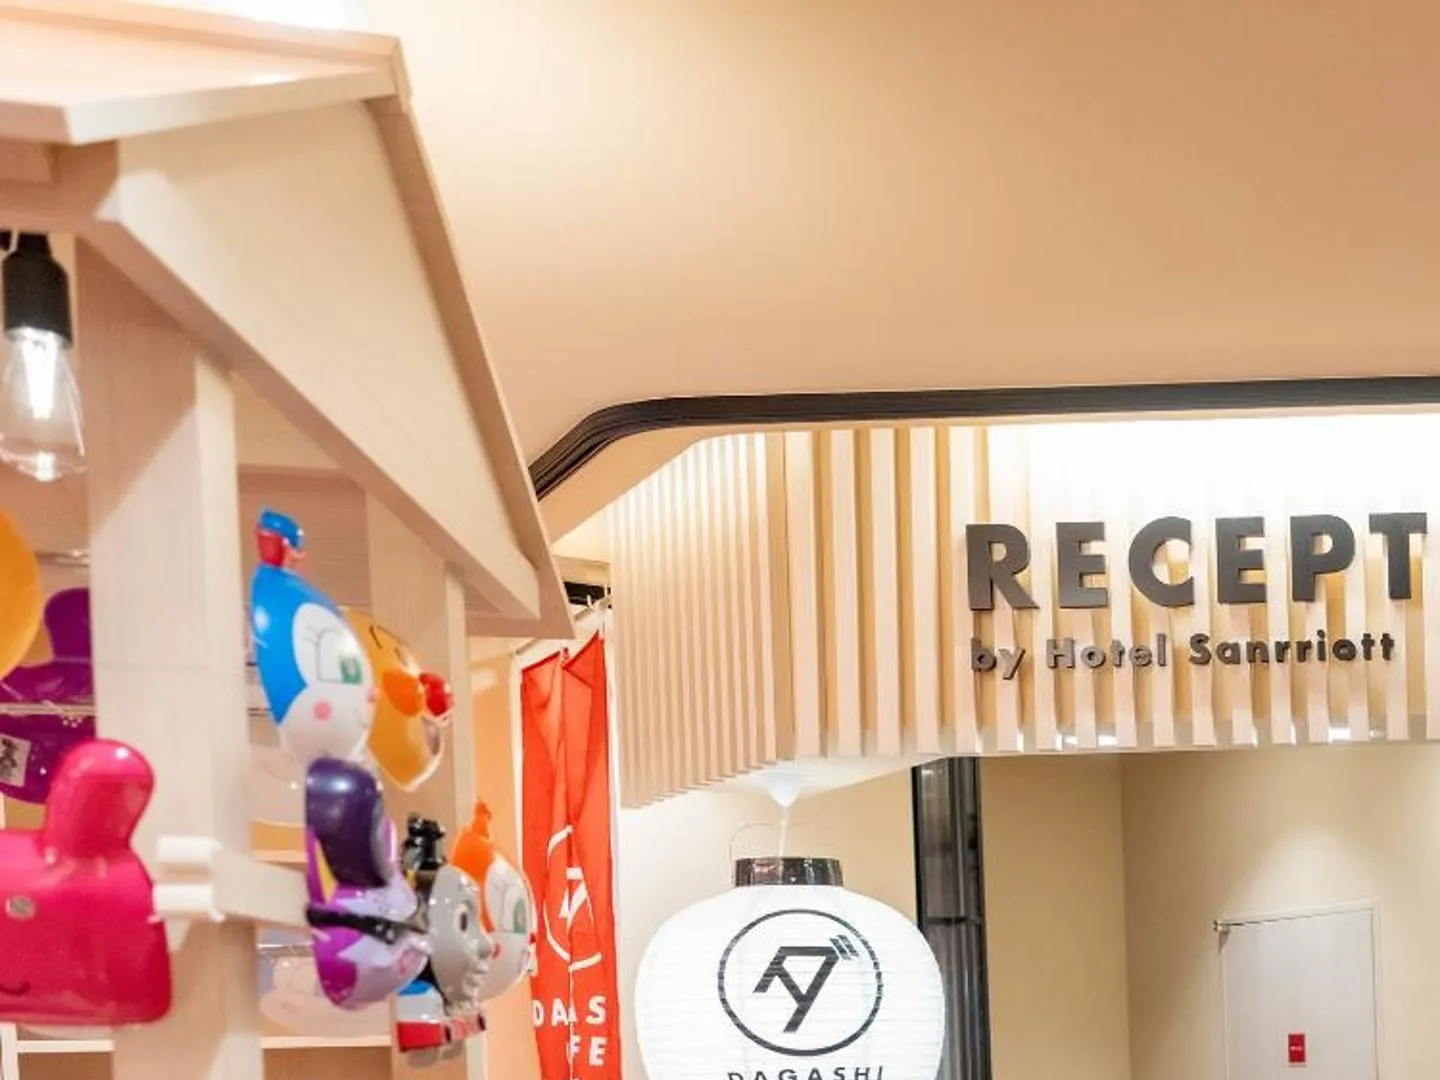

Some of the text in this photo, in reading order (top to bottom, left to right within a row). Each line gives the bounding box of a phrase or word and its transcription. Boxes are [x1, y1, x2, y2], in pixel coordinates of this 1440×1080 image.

[970, 629, 1395, 680] by Hotel Sanrriott
